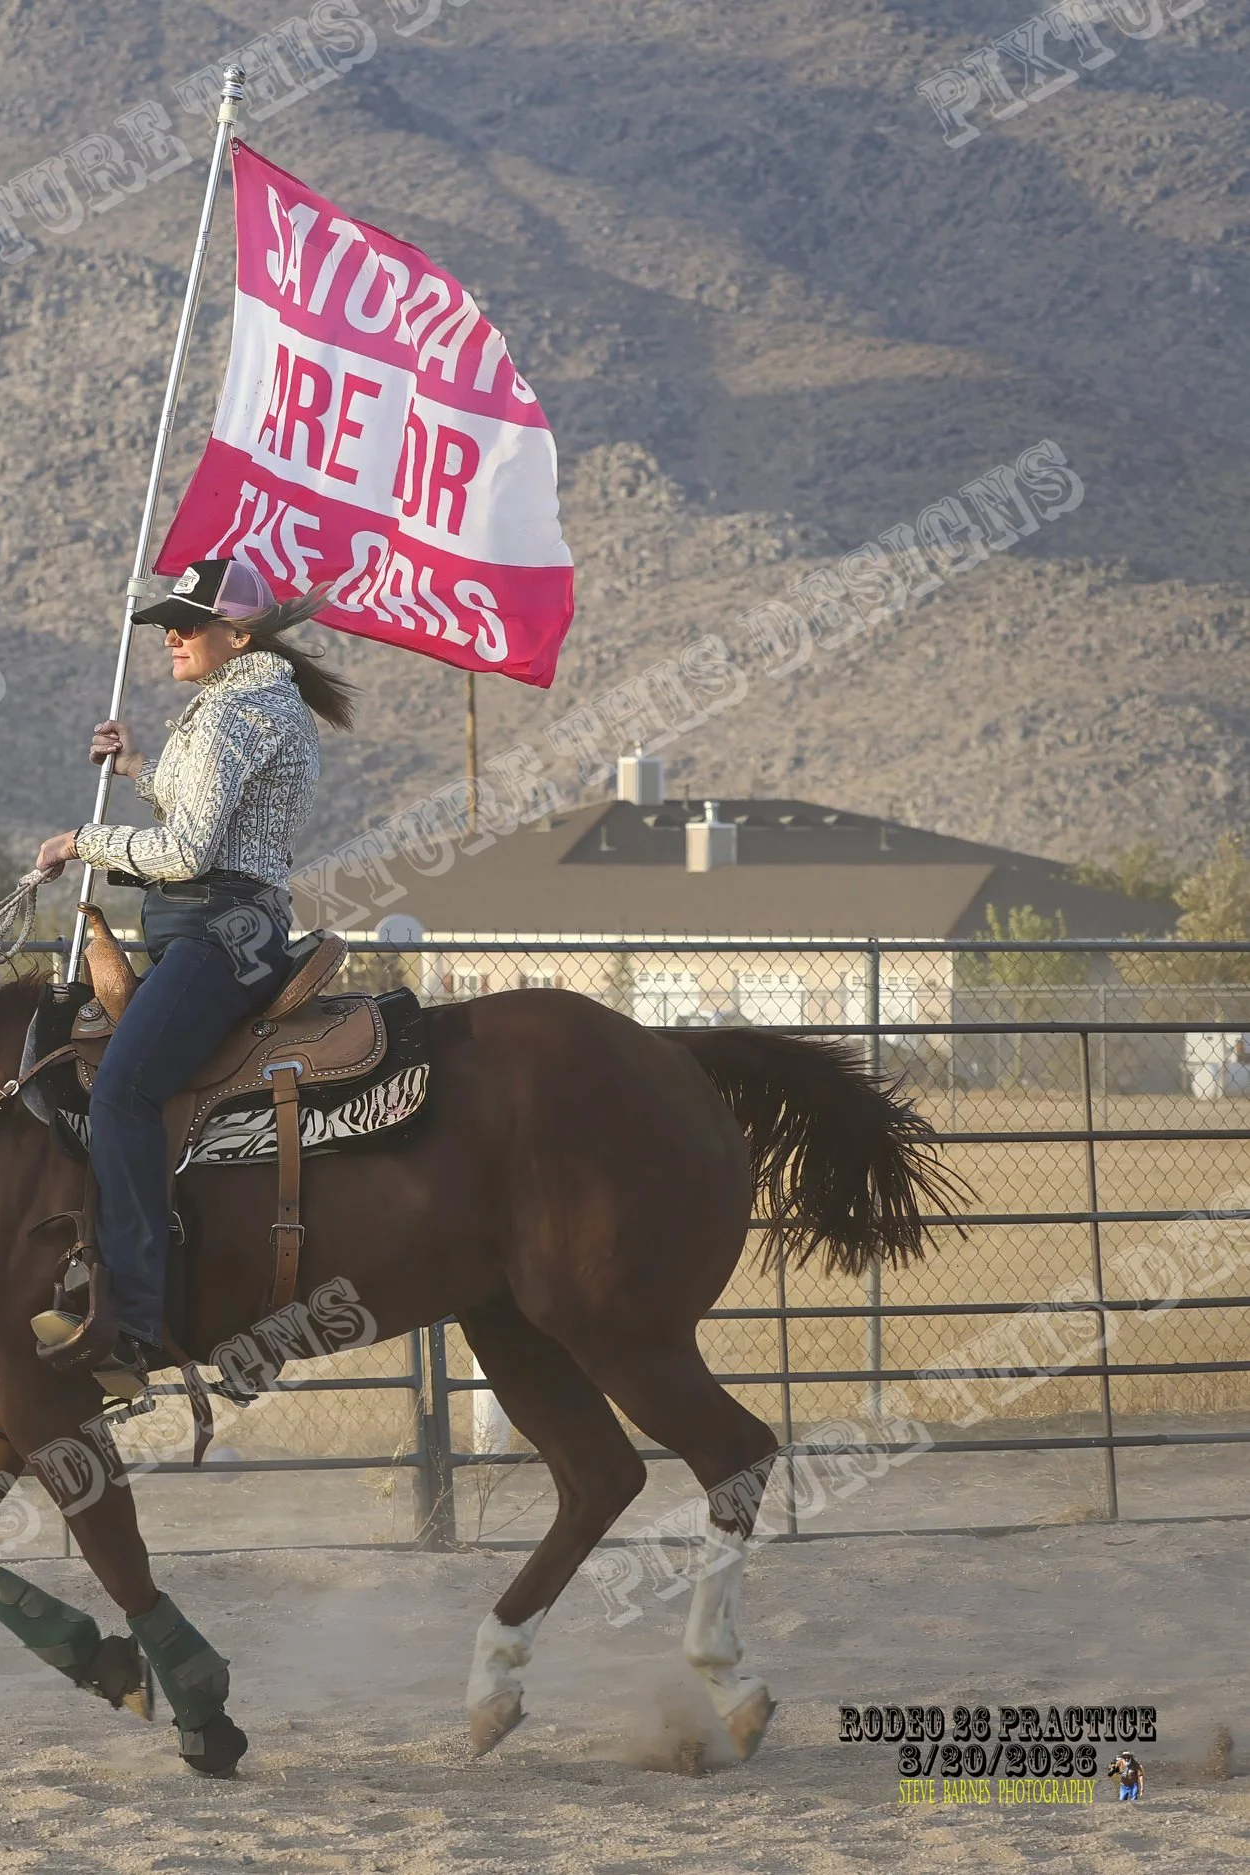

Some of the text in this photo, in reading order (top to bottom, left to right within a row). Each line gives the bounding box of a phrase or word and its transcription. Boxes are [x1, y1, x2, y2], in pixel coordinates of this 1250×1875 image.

[258, 343, 382, 486] ARE
[205, 480, 509, 663] THE GIRLS
